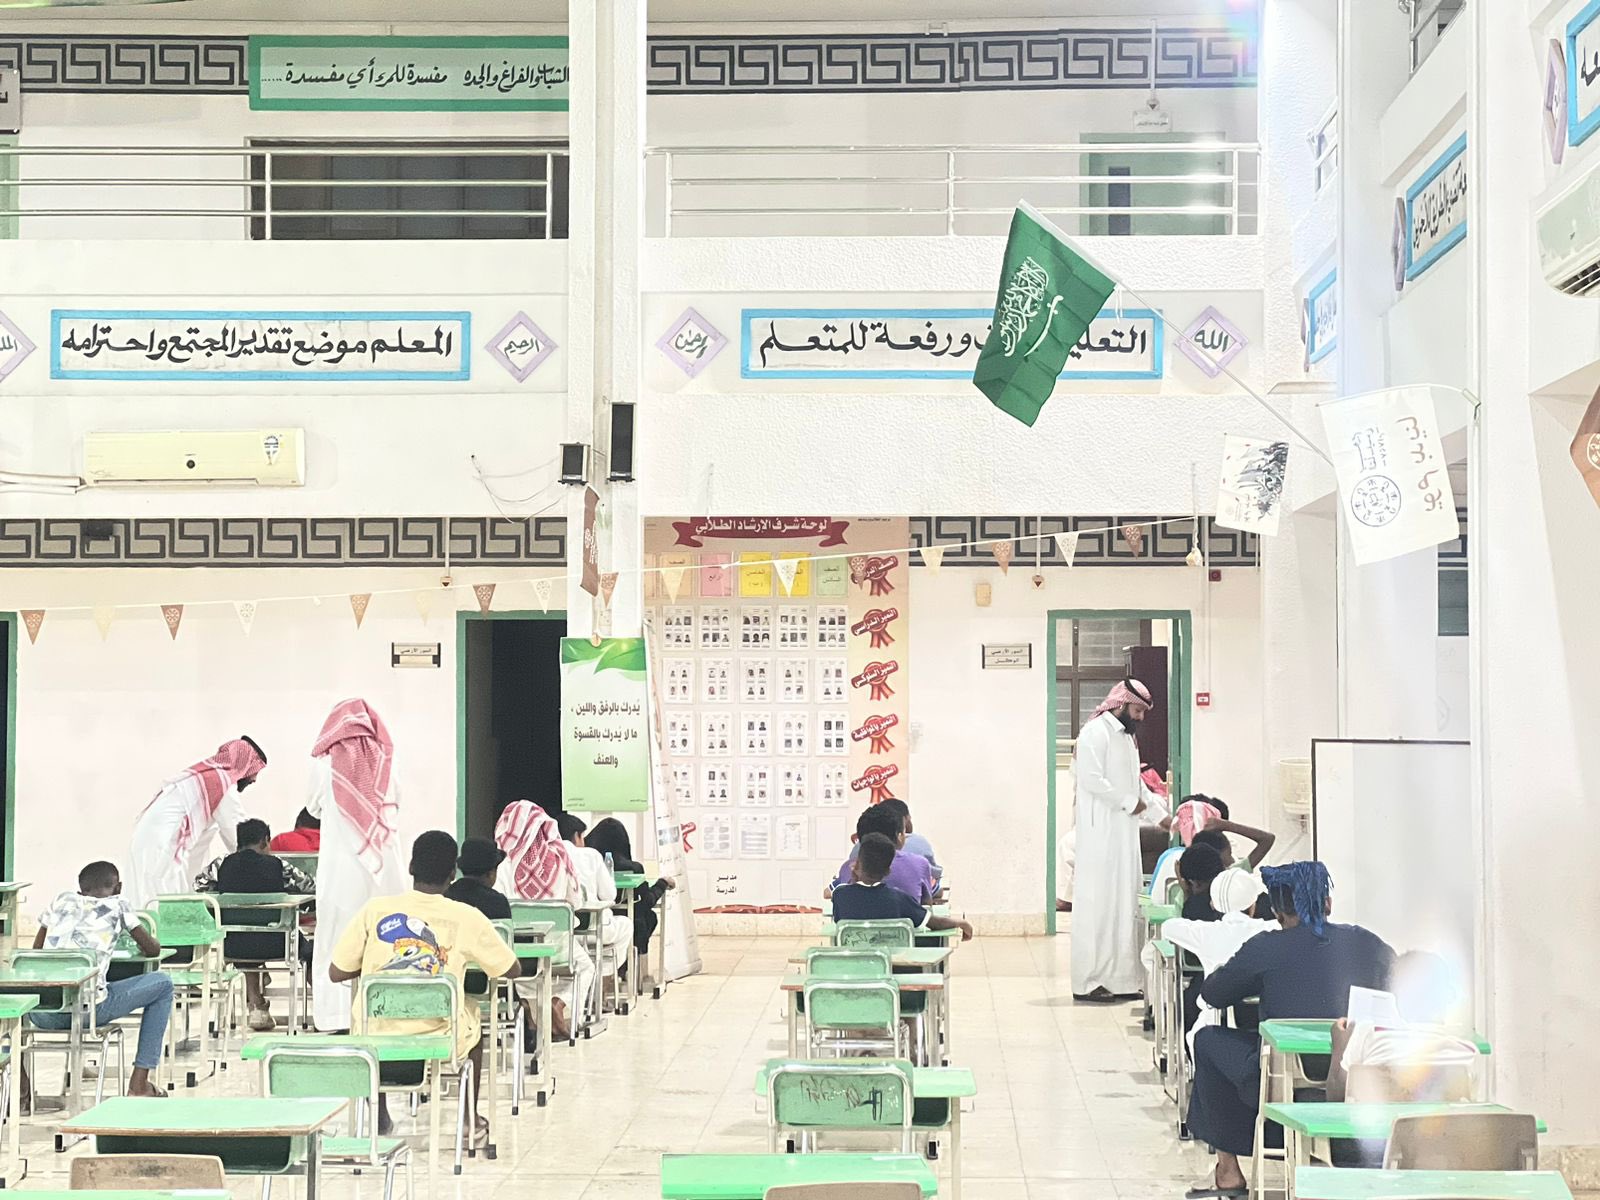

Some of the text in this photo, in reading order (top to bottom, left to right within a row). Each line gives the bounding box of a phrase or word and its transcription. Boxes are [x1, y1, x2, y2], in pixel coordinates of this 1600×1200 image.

[285, 62, 345, 84] مفسدة
[346, 57, 376, 88] أي
[407, 63, 448, 85] مفسدة
[498, 60, 541, 92] والفراغ
[61, 322, 452, 366] المعلم موضع تقدير المجتمع واحترامه
[504, 337, 540, 358] الرحيم
[760, 320, 868, 368] للمتعلم
[875, 321, 972, 357] ورفعة
[1069, 325, 1147, 360] التعلي
[1194, 328, 1230, 352] الله
[772, 517, 800, 533] شرف
[800, 518, 828, 533] لوحة
[576, 702, 597, 716] واللين
[598, 700, 620, 716] بالرفق
[573, 726, 601, 742] بالقسوة
[631, 729, 638, 739] ما
[593, 753, 619, 768] والعنف
[716, 886, 737, 895] المدرسة
